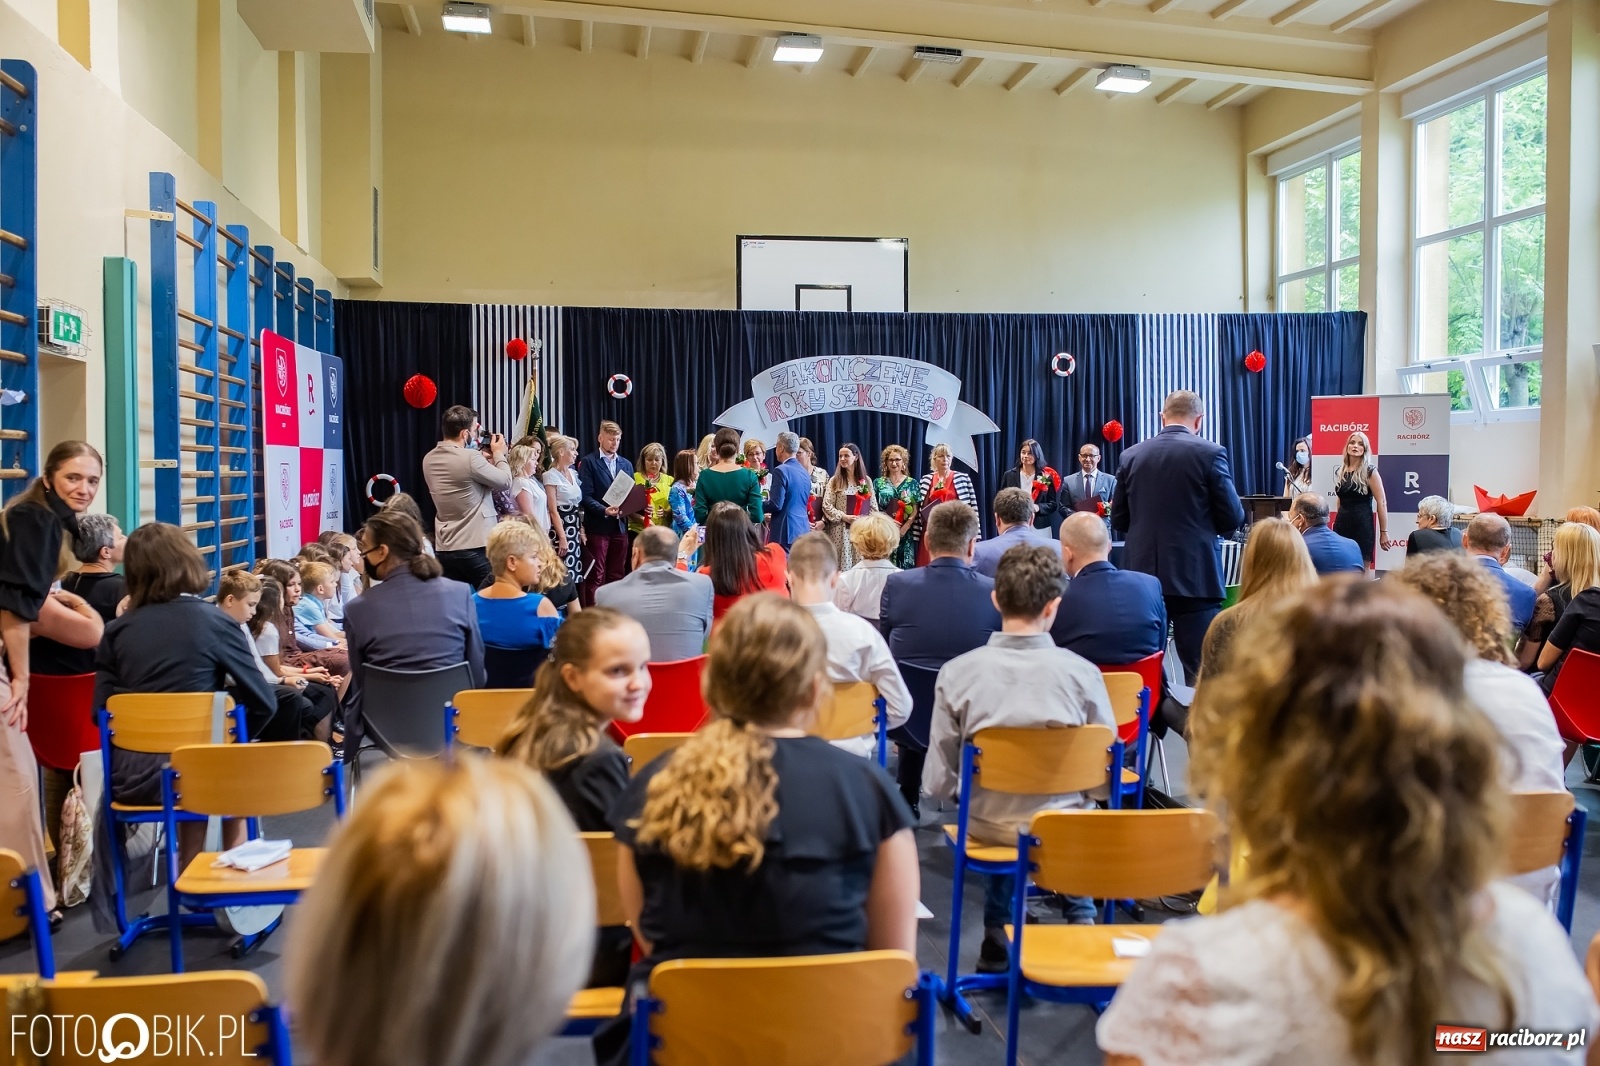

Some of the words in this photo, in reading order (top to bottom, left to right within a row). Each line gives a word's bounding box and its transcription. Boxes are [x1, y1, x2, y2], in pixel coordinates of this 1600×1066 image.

[770, 356, 930, 393] ZAKOŃCZENIE
[307, 373, 315, 404] R
[765, 387, 826, 422] ROKU
[829, 384, 948, 421] SZKOLNEGO
[1320, 421, 1370, 432] RACIBÓRZ
[1396, 432, 1430, 440] RACIBÓRZ
[1404, 471, 1420, 488] R
